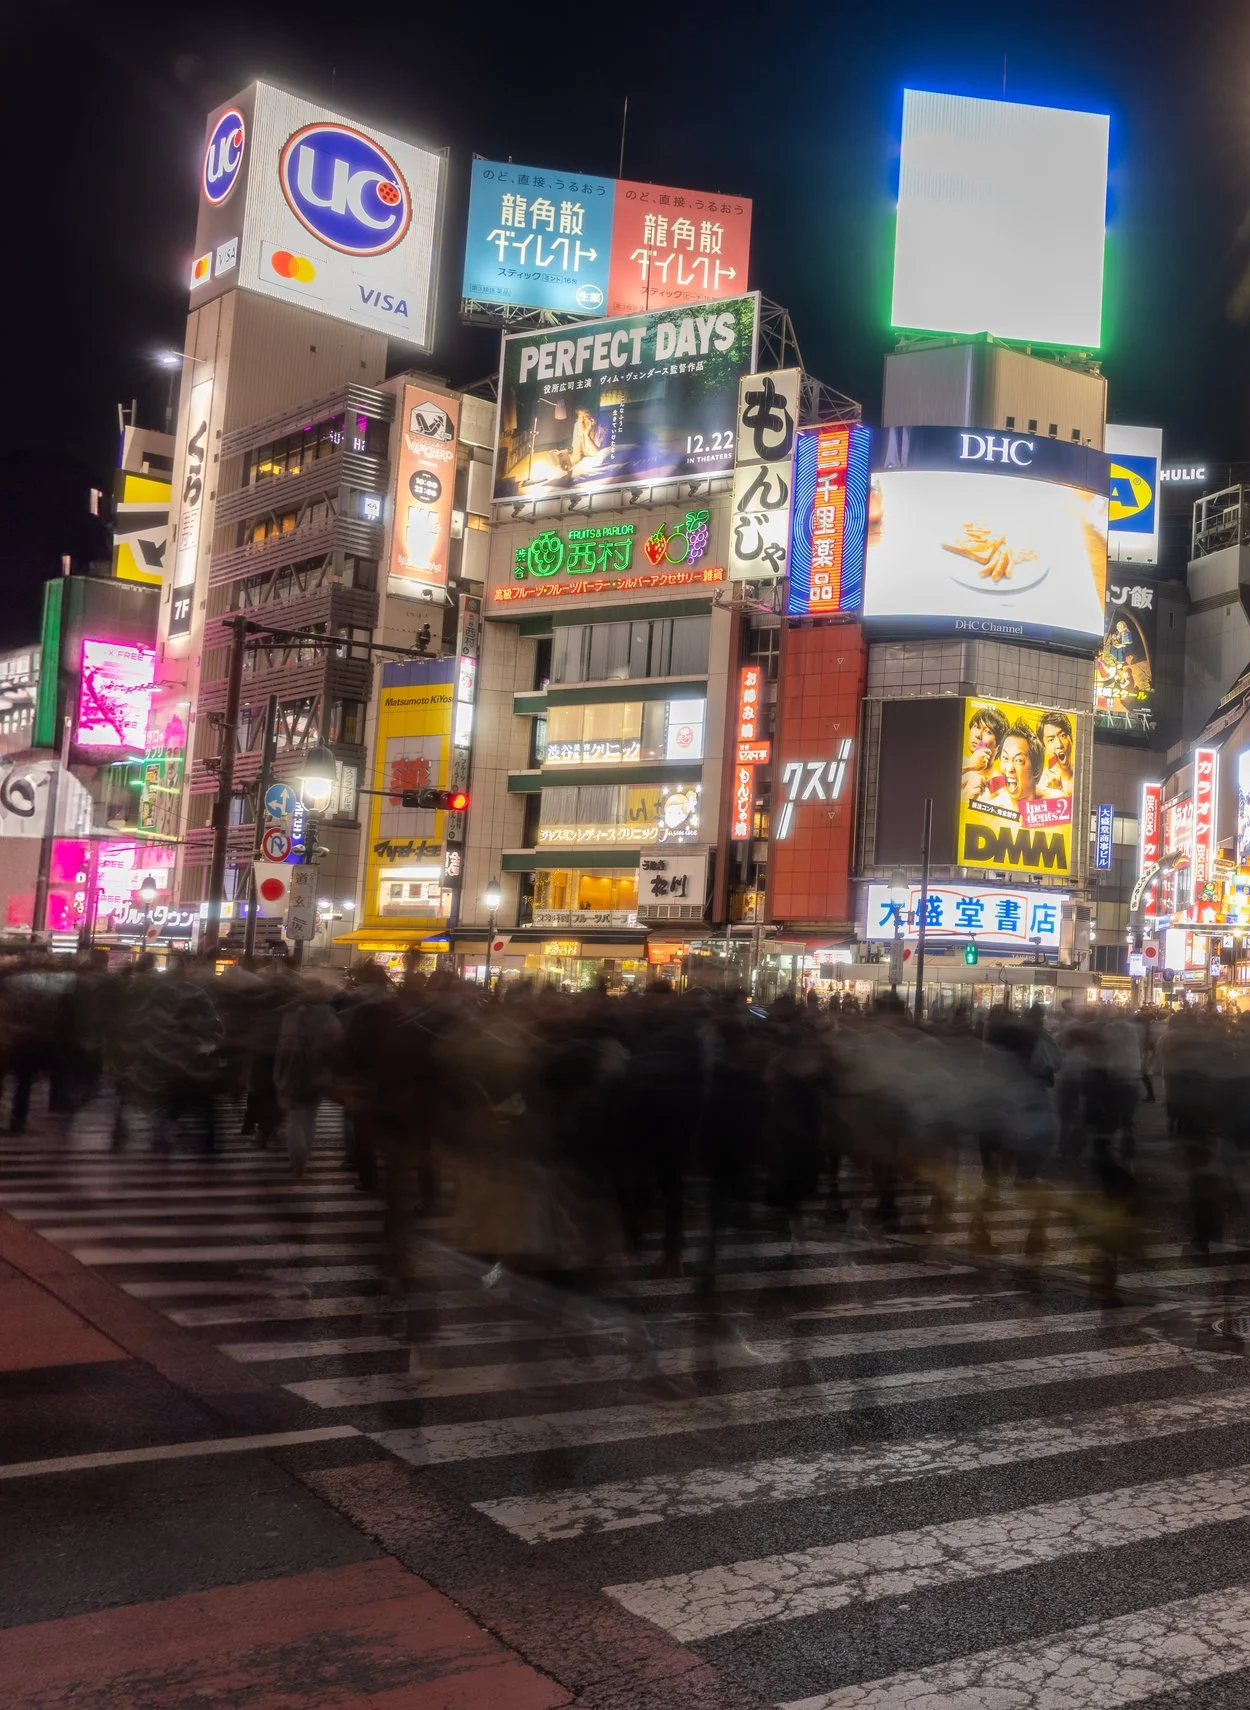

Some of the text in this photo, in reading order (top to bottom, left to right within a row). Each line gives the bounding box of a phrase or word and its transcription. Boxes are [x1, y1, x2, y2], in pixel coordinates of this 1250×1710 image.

[300, 145, 396, 230] UC
[501, 193, 585, 236] 龍角散
[486, 228, 598, 272] ダイレクト
[643, 213, 724, 254] 龍角散
[498, 267, 541, 280] スティック
[630, 248, 737, 290] ダイレクト
[358, 284, 409, 318] VISA
[519, 312, 736, 384] PERFECT DAYS
[686, 431, 734, 454] 12.22
[696, 453, 733, 463] THEATERS
[960, 433, 1034, 466] DHC
[734, 376, 794, 574] もんじゃ
[1160, 467, 1205, 481] HULIC
[809, 438, 842, 601] 三千里薬品
[567, 539, 632, 575] 西村
[174, 598, 190, 620] 7F
[955, 619, 1023, 635] DHC Channel
[117, 650, 144, 662] FREE
[385, 696, 428, 708] Matsumoto
[1196, 760, 1214, 835] カラオケ
[659, 828, 698, 842] Jasmine
[964, 823, 1068, 870] DMM
[878, 895, 1057, 934] 大盛堂書店
